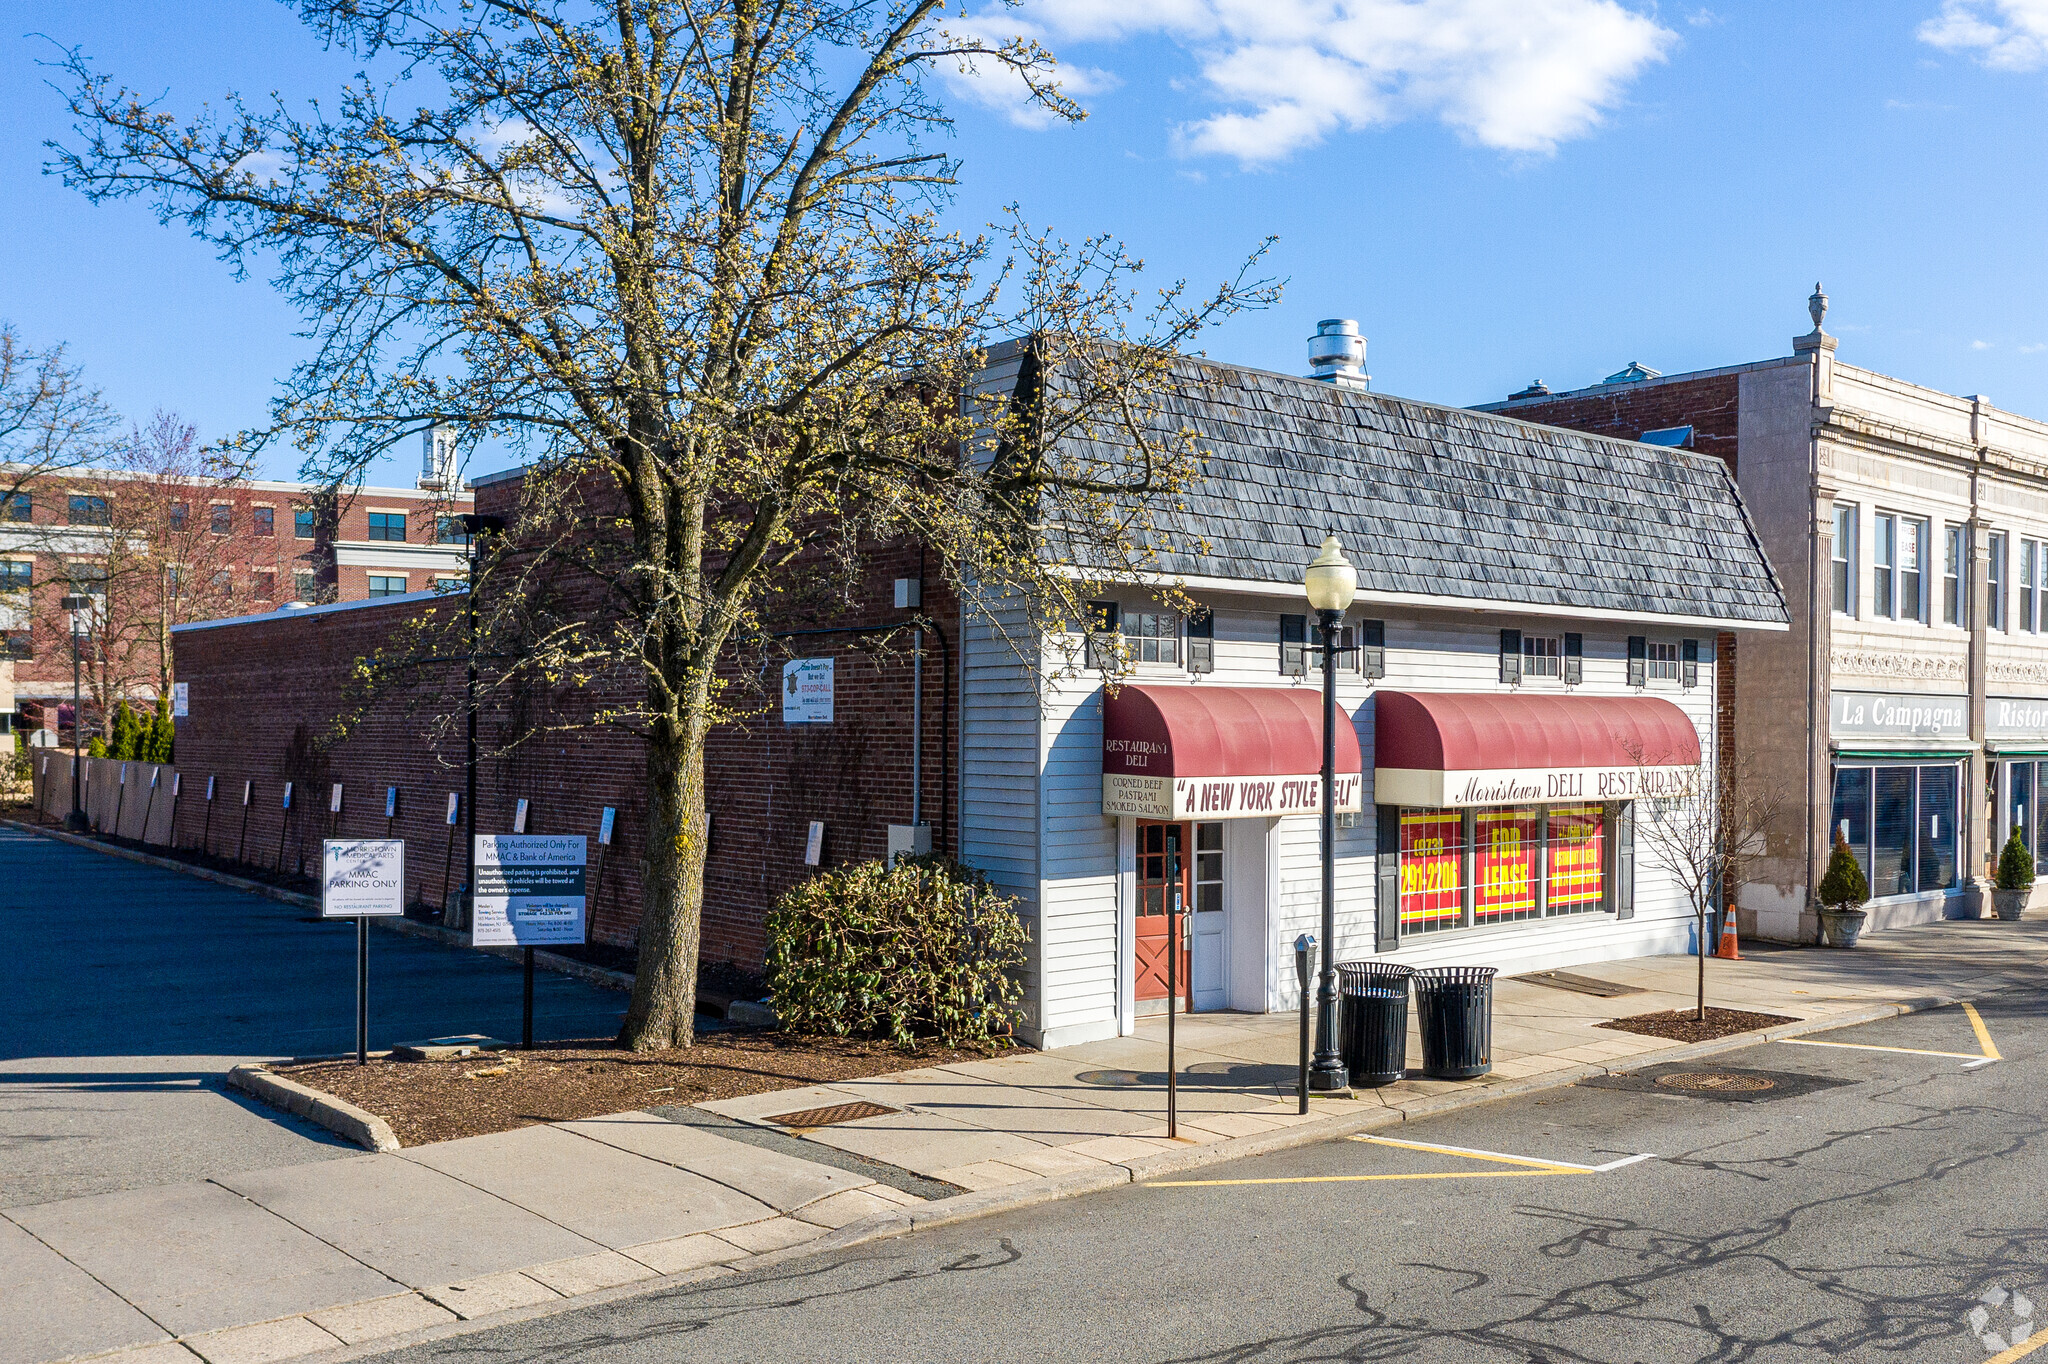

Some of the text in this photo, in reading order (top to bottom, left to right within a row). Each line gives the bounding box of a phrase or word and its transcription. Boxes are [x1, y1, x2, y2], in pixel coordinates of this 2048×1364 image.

[1901, 542, 1915, 553] EASE
[1841, 696, 1962, 734] La Campagna
[1106, 740, 1167, 754] RESTAURANT
[1126, 754, 1148, 767] DELI
[1112, 778, 1164, 790] CORNED BEEF
[1455, 770, 1692, 803] Morristown DELI RESTAURANT
[1118, 789, 1157, 802] PASTRAMI
[1200, 783, 1235, 812] NEW
[1240, 781, 1275, 812] YORK
[1280, 780, 1318, 809] STYLE
[1333, 775, 1359, 806] ELI"
[1106, 801, 1169, 815] SMOKED SALMON
[482, 840, 579, 850] Parking Authorized Only For
[1414, 838, 1444, 856] (973)
[1492, 827, 1520, 859] FOR
[485, 853, 511, 861] MMAC
[548, 853, 576, 861] America
[330, 880, 397, 888] PARKING ONLY
[1401, 861, 1457, 896] 291-2206
[1484, 863, 1528, 897] LEASE
